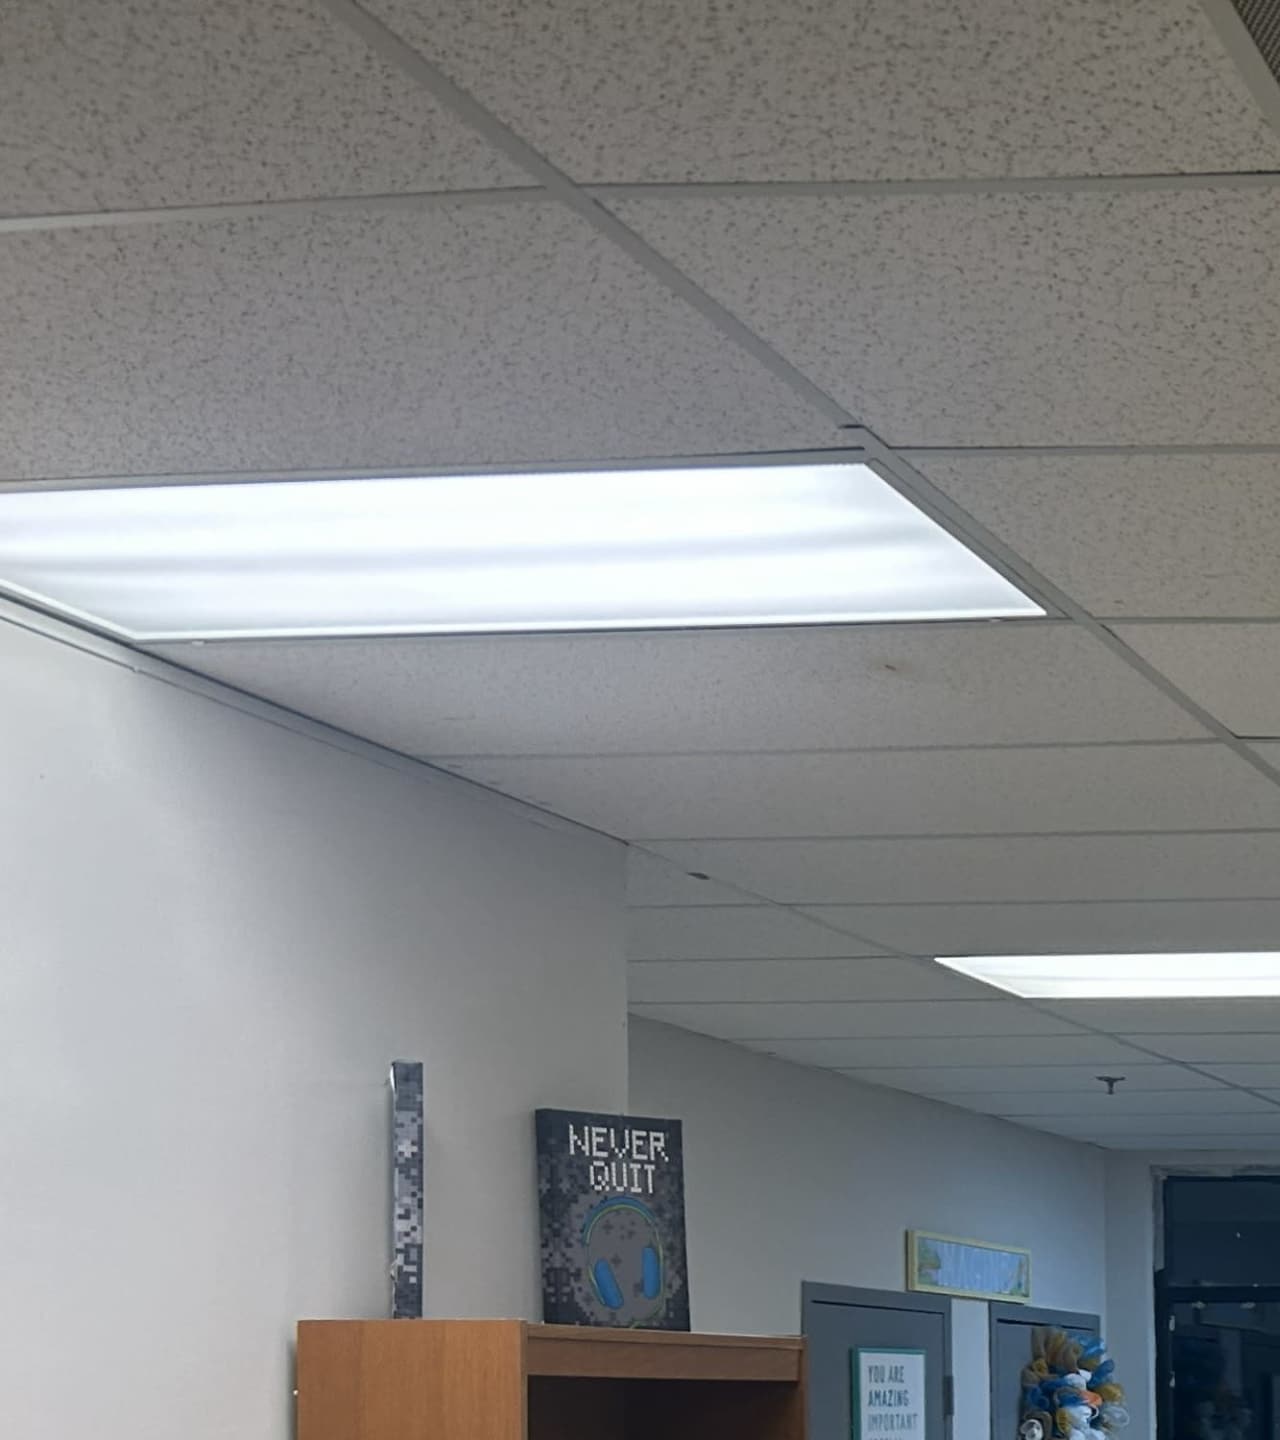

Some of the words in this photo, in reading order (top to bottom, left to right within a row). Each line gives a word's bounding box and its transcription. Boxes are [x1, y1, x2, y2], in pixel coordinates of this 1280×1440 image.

[568, 1123, 669, 1163] NEVER
[588, 1160, 656, 1194] QUIT
[868, 1365, 885, 1383] YOU
[888, 1365, 905, 1383] ARE
[868, 1389, 909, 1407] AMAZING
[867, 1413, 918, 1431] IMPORTANT
